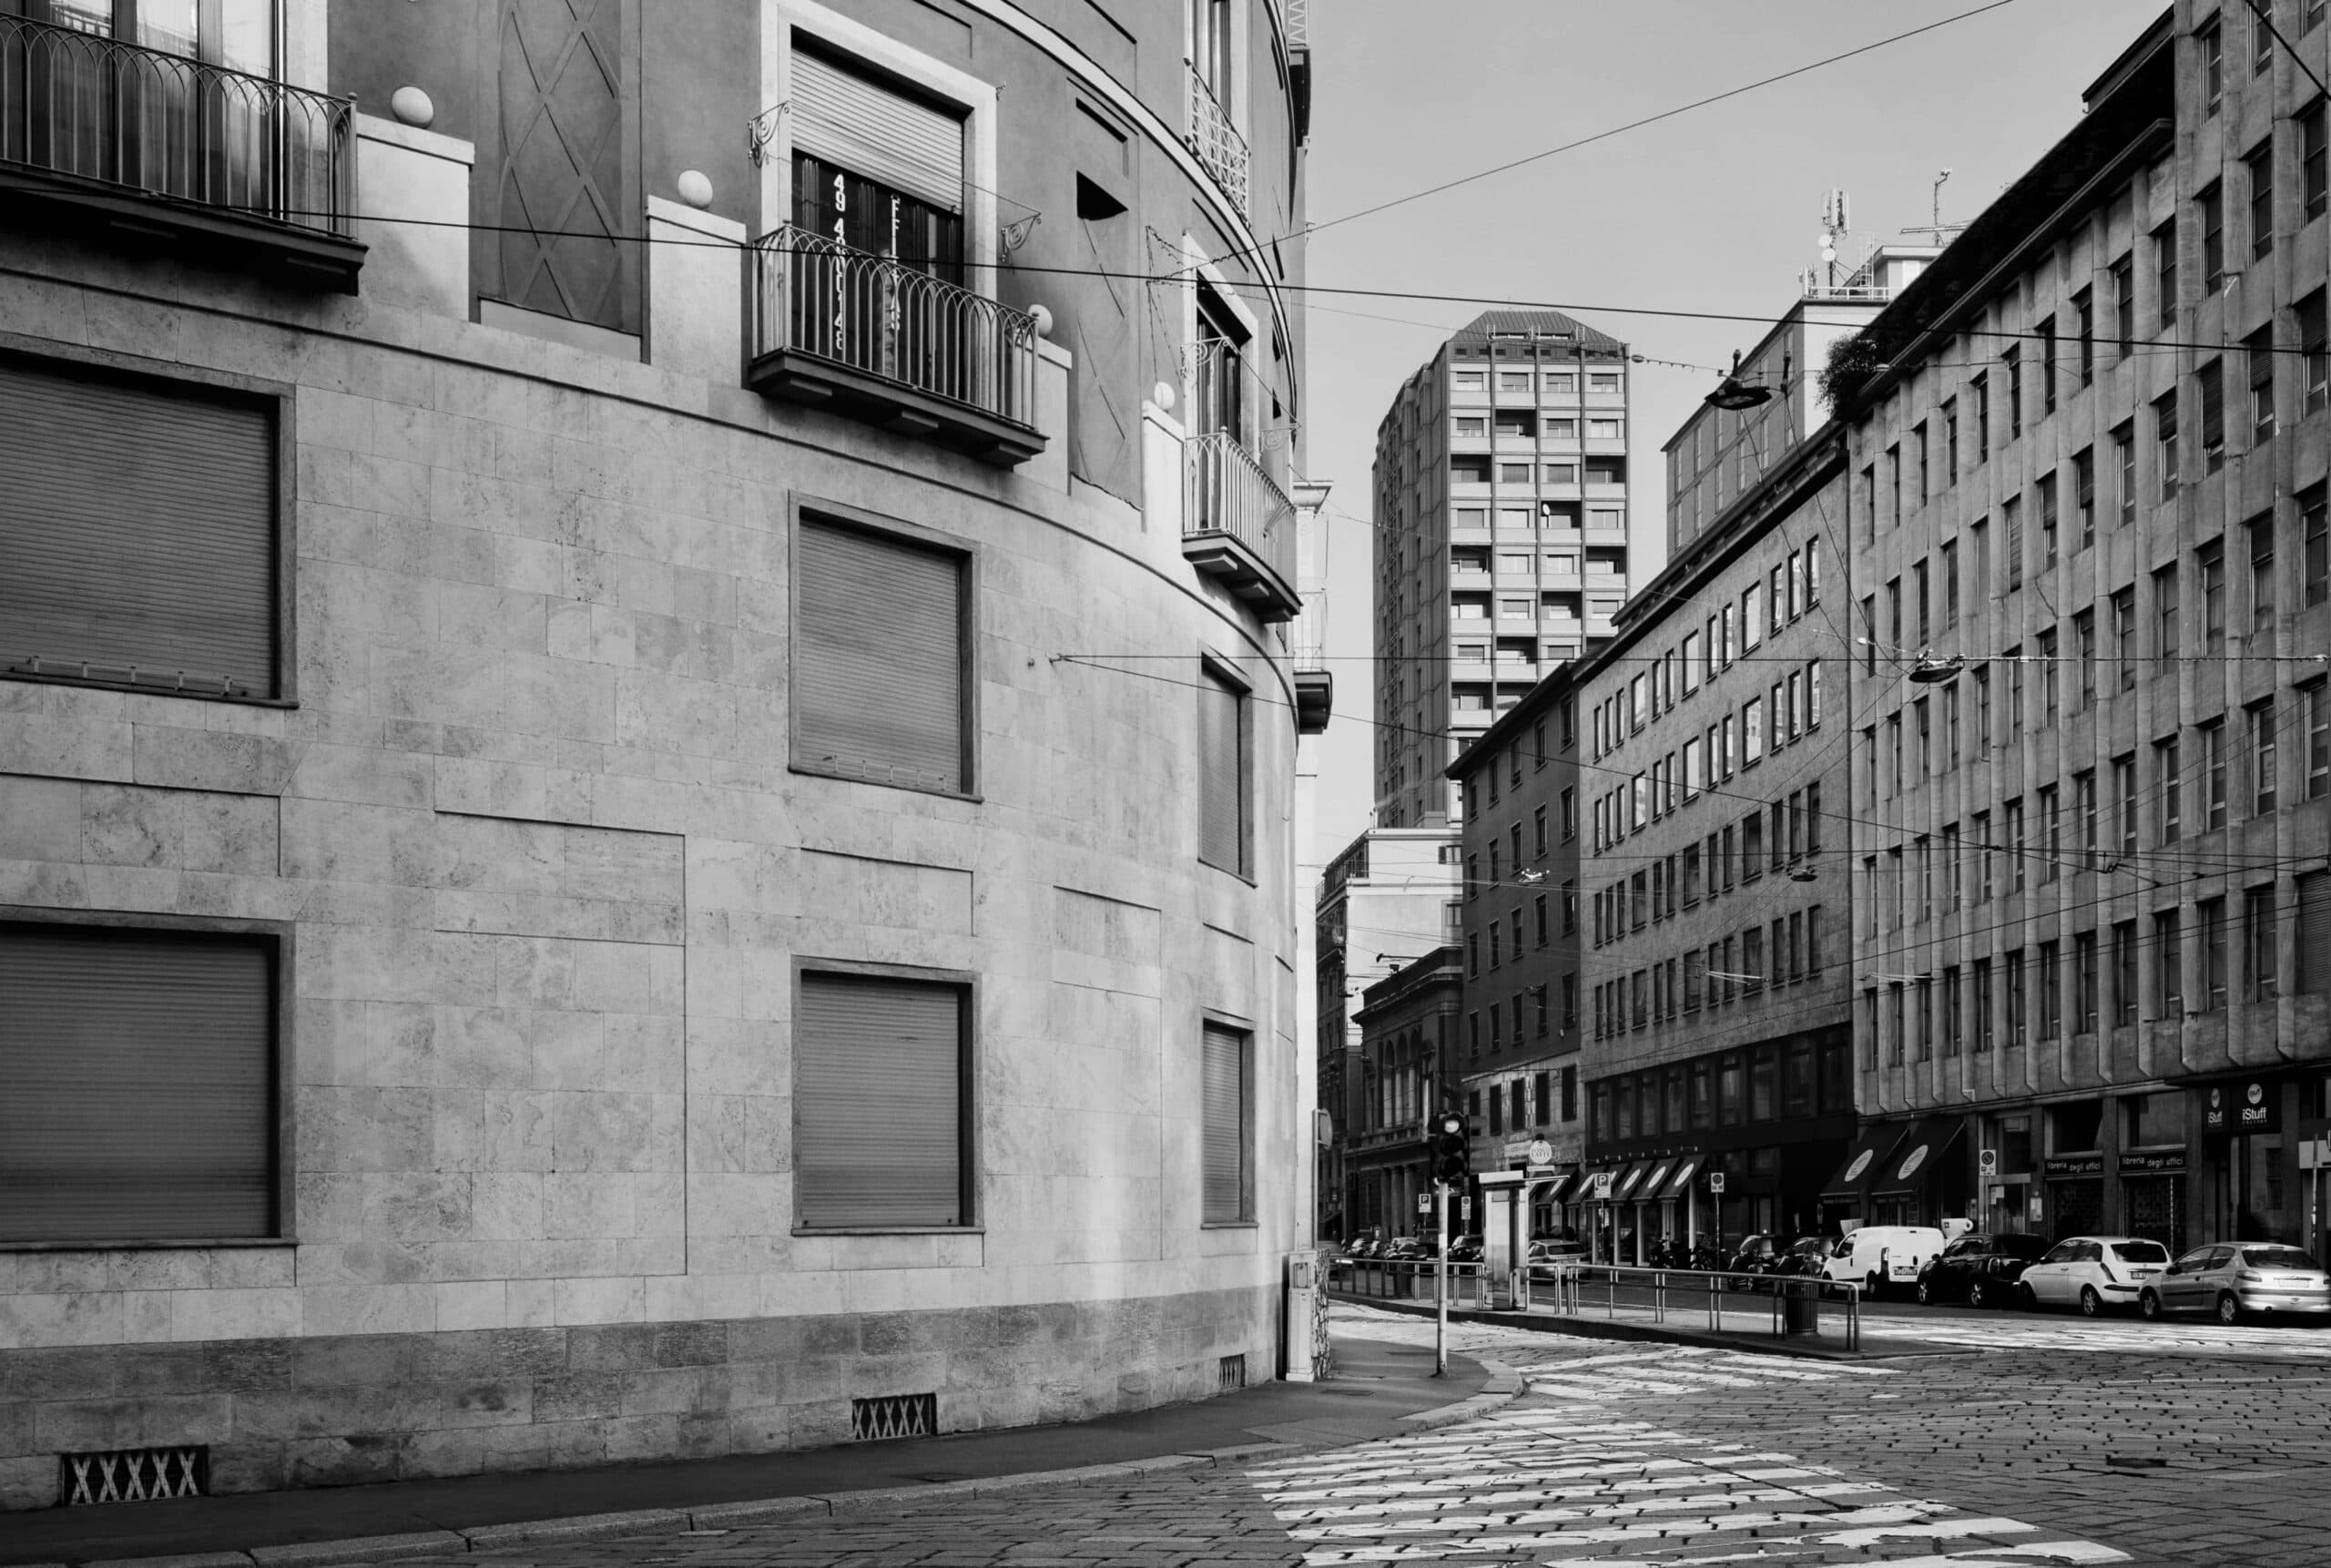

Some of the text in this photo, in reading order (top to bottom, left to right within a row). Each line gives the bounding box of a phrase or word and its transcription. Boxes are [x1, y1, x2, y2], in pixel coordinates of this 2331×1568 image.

[2242, 1106, 2267, 1121] iStuff
[2047, 1161, 2068, 1169] libreria
[2069, 1162, 2084, 1174] degli
[2122, 1156, 2183, 1169] libreria degli uffici
[1599, 1176, 1607, 1186] P
